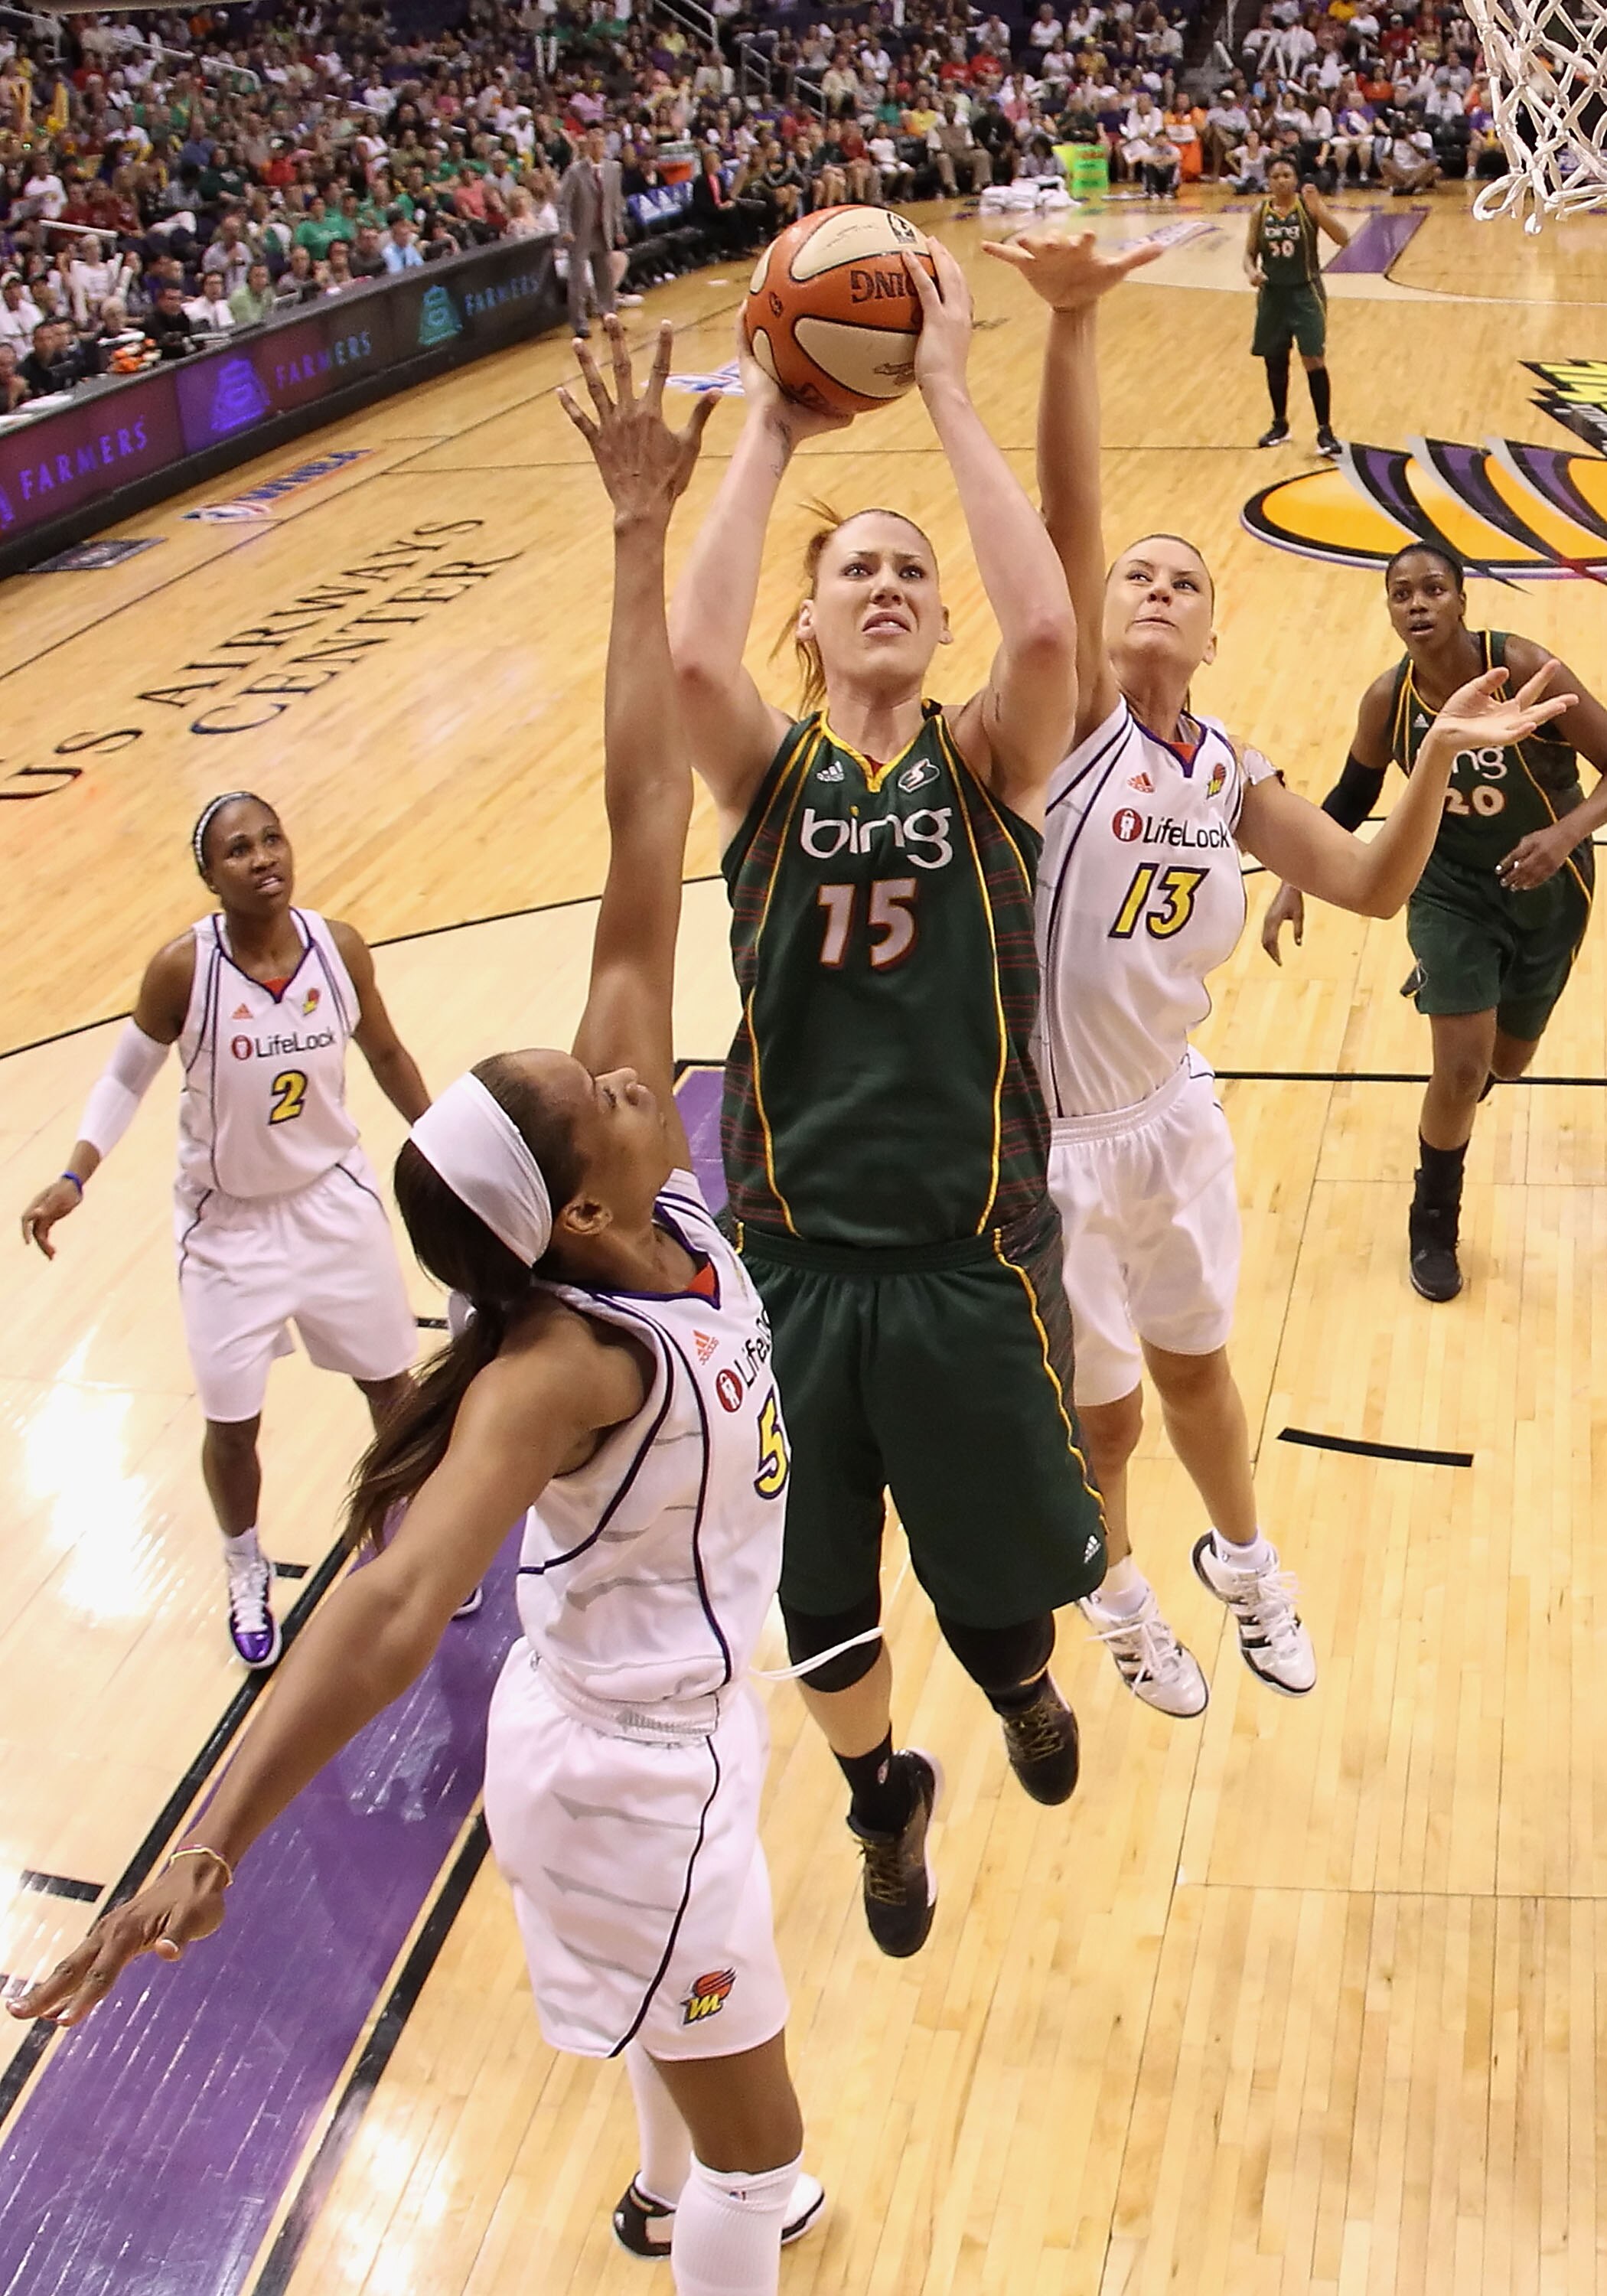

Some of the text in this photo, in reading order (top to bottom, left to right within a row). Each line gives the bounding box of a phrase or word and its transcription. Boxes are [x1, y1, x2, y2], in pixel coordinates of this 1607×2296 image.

[275, 331, 372, 390] FARMERS
[18, 415, 148, 501] FARMERS
[136, 519, 485, 708] AIRWAYS
[191, 550, 525, 735] CENTER
[1451, 746, 1508, 779] ng
[800, 805, 953, 869] bing
[1142, 816, 1231, 849] LifeLock
[816, 877, 918, 970] 15
[1107, 862, 1211, 940] 13
[254, 1026, 335, 1058] LifeLock
[268, 1068, 308, 1126] 2
[753, 1384, 788, 1500] 5
